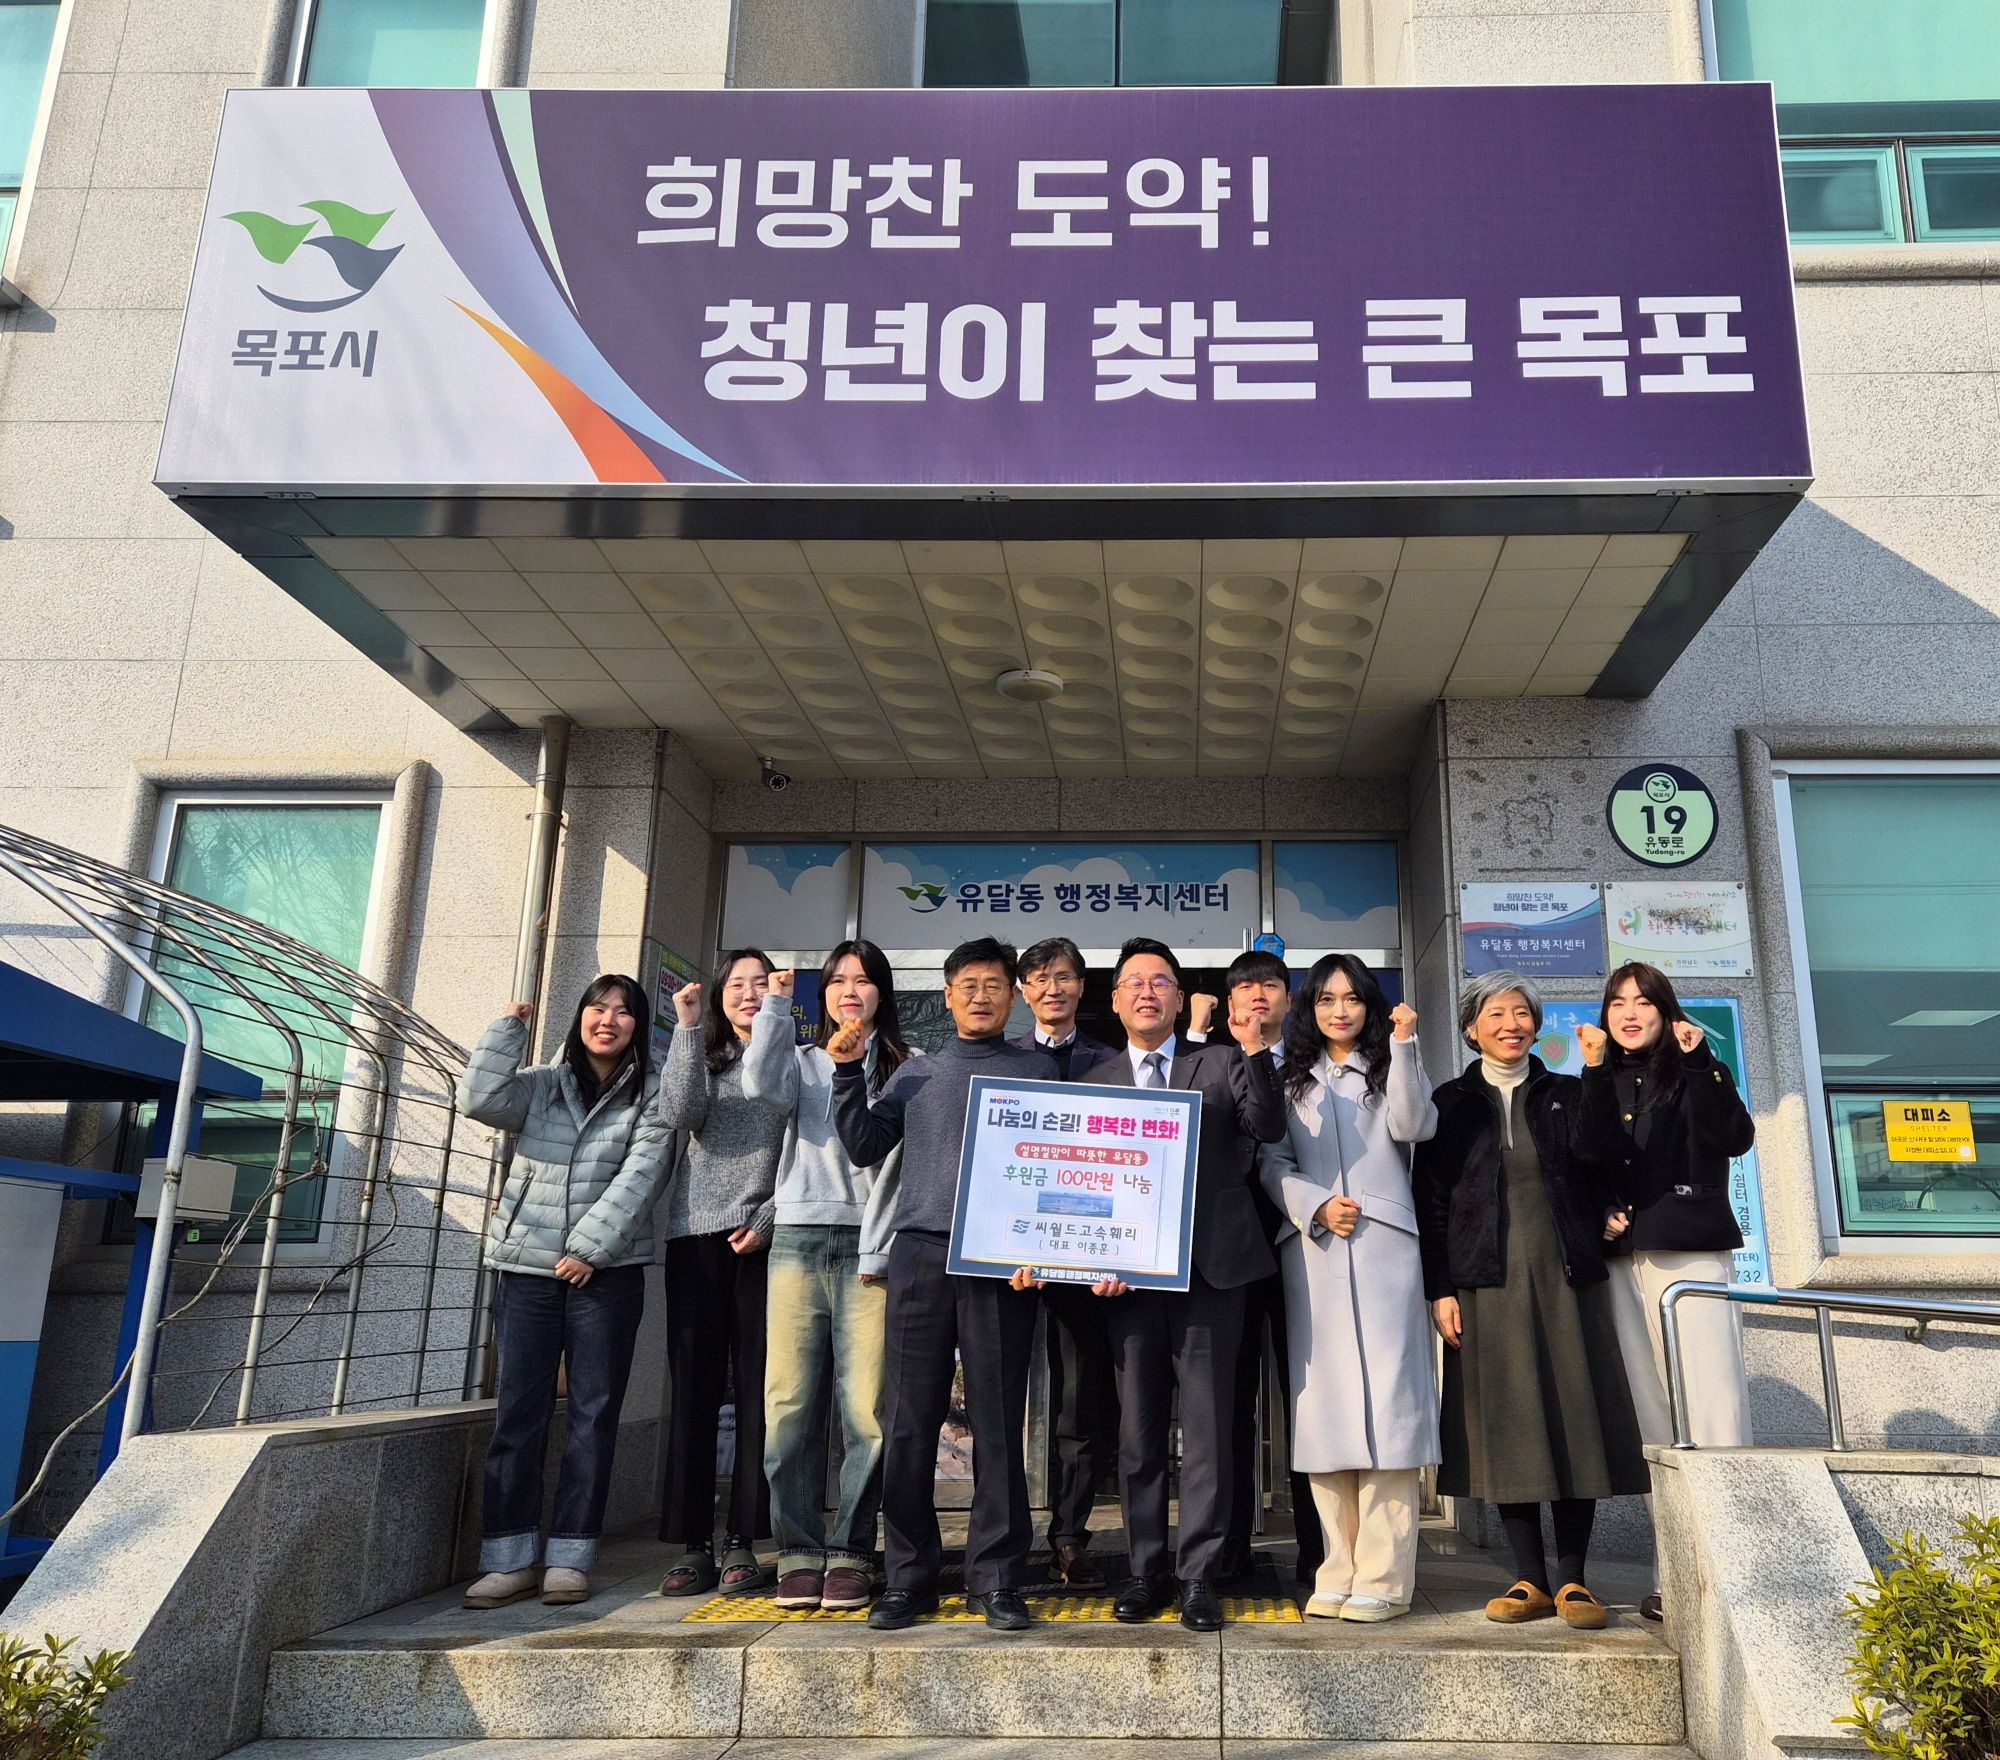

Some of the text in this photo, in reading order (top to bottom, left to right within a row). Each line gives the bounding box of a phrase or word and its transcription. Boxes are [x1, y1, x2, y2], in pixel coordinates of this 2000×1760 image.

[637, 156, 1269, 249] 희망찬 도약!
[231, 329, 379, 378] 목포시
[700, 295, 1755, 401] 청년이 찾는 큰 목포
[1640, 805, 1687, 834] 19
[1645, 836, 1684, 848] 유동로
[1645, 848, 1685, 856] Yudong-ro
[955, 882, 1231, 913] 유달동 행정복지센터
[1493, 903, 1569, 912] 청년이 찾는 큰 목포
[1480, 939, 1586, 951] 유달동 행정복지센터
[989, 1097, 1020, 1106] MOKPO
[1904, 1108, 1951, 1122] 대피소
[987, 1108, 1180, 1140] 나눔의 손길! 행복한 변화!
[1021, 1144, 1142, 1165] 설명절맞이 따뜻한 유달동
[1003, 1165, 1153, 1194] 후원금 100만원 나눔
[1734, 1173, 1748, 1203] 쉼터
[1737, 1206, 1752, 1237] 겸용
[1049, 1240, 1070, 1250] 대표
